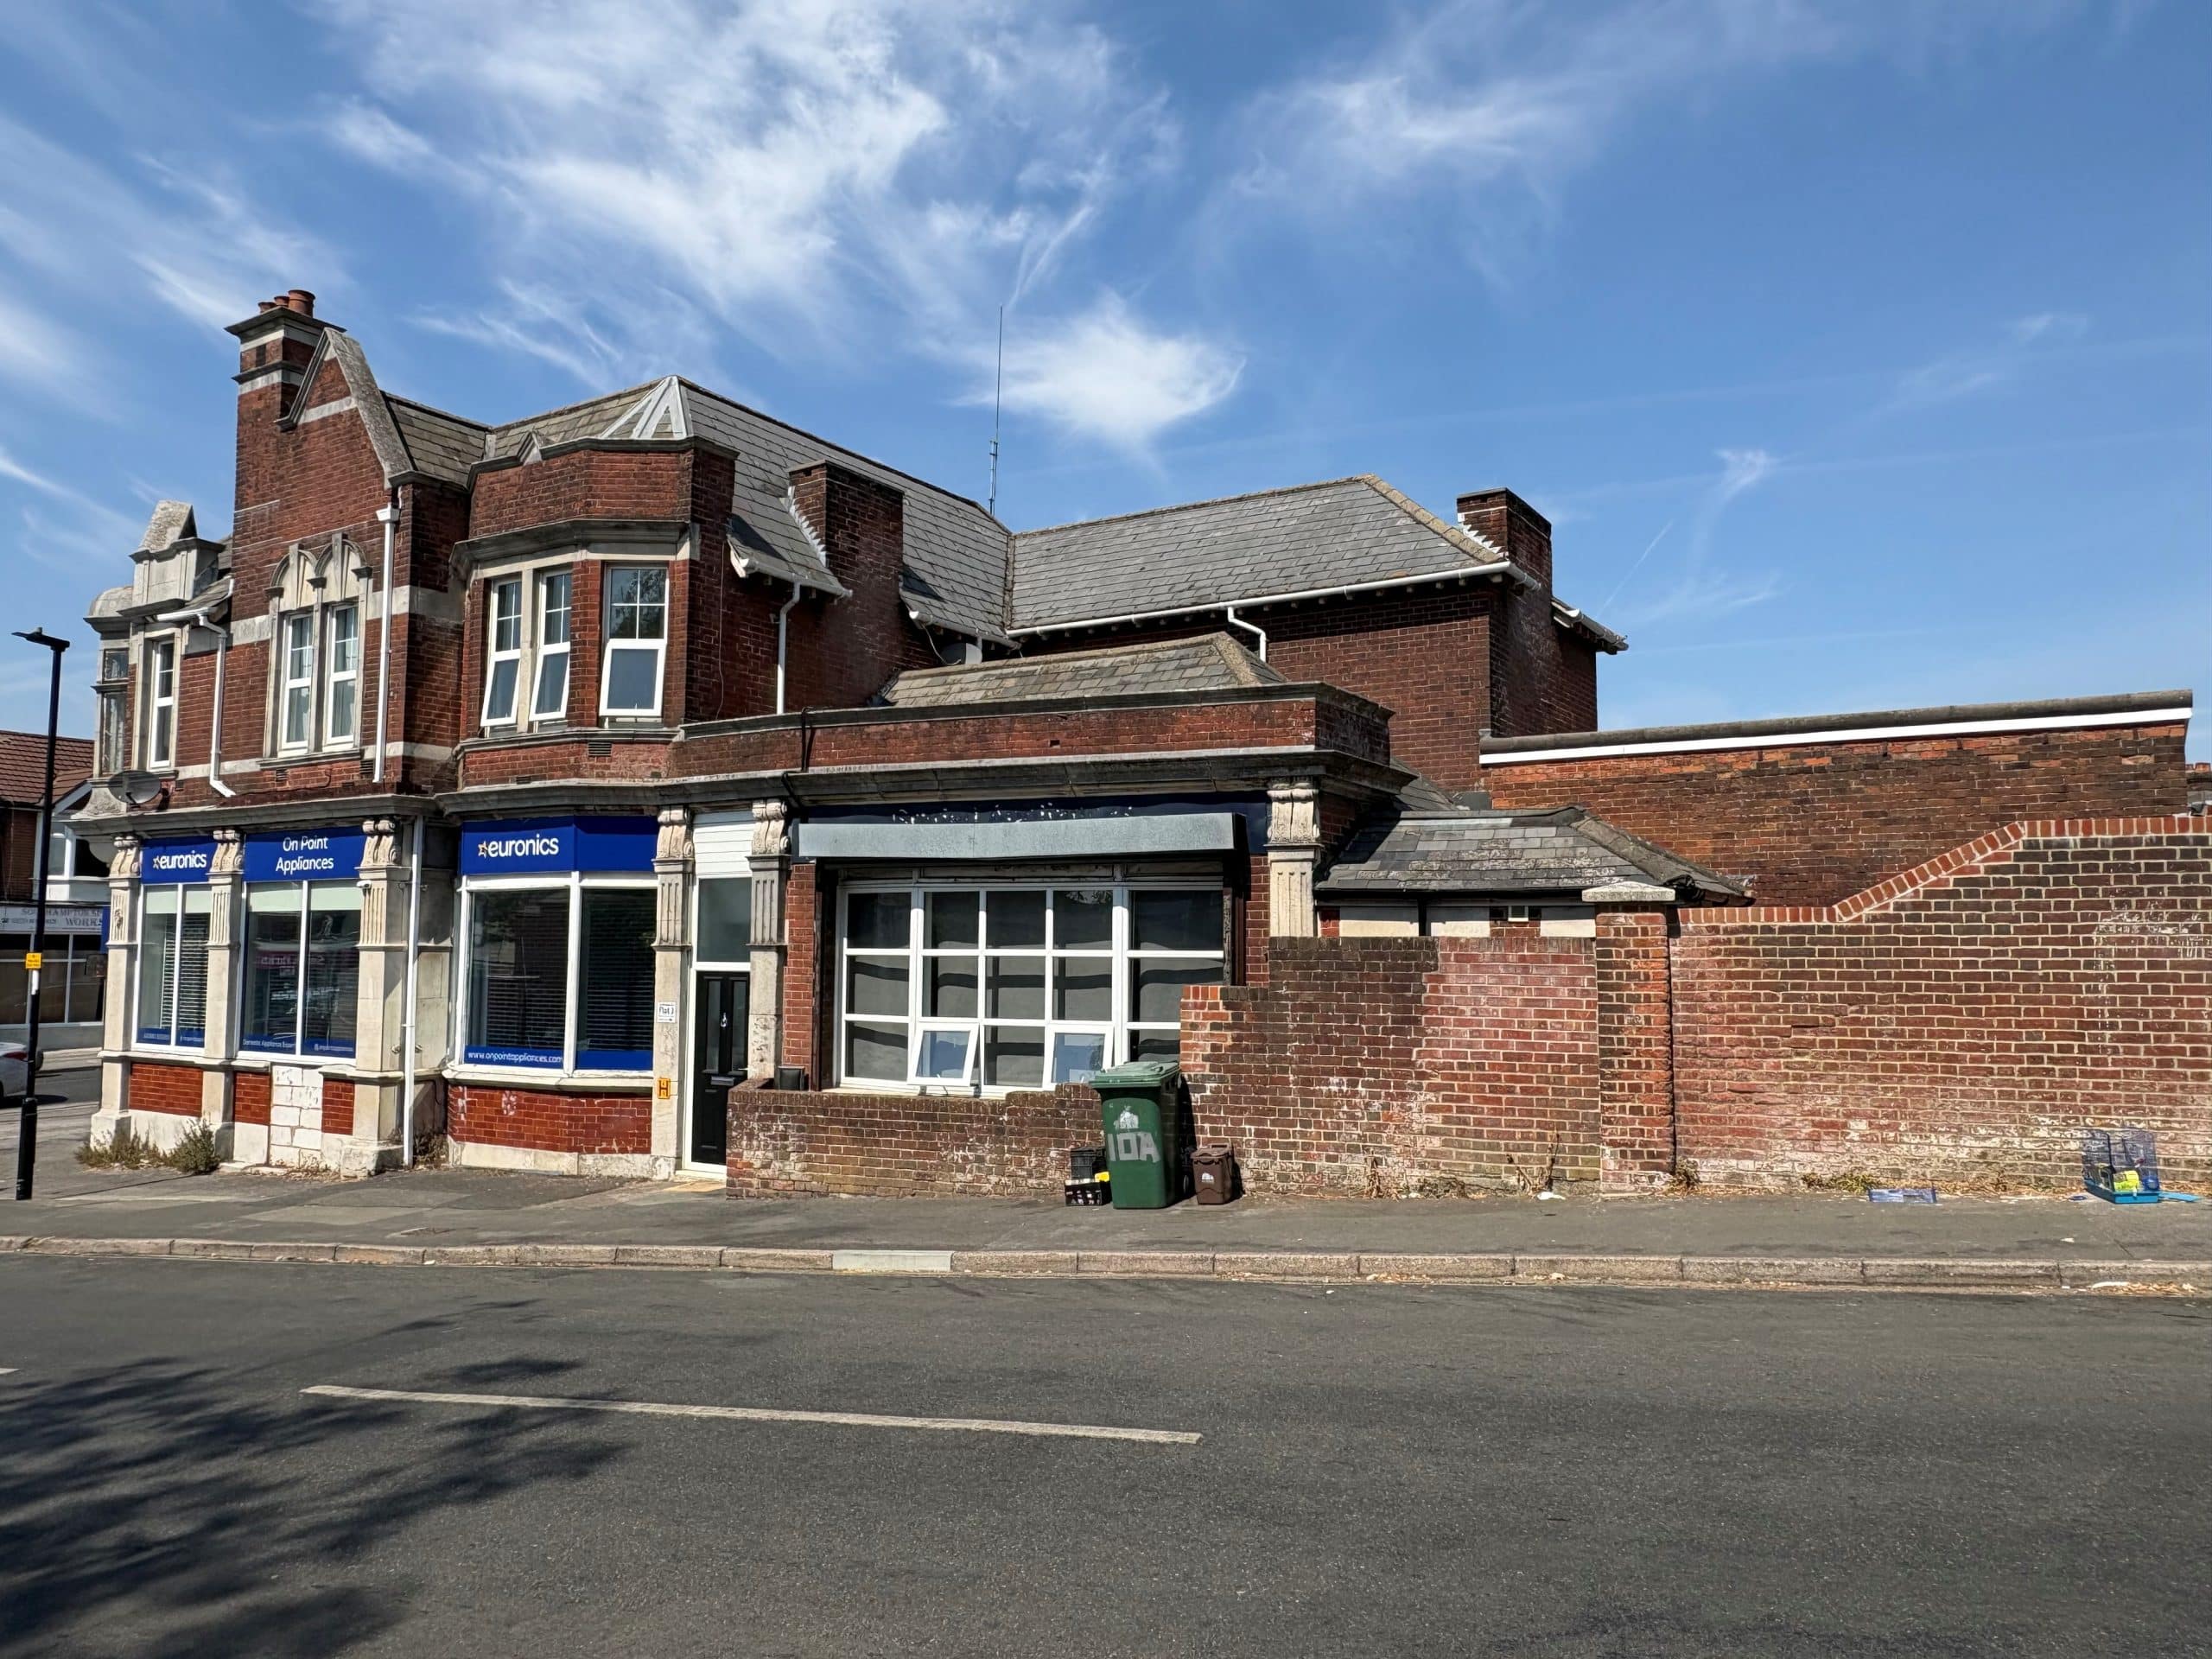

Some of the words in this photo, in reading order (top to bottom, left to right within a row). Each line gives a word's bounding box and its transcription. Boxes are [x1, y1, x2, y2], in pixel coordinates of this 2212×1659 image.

[283, 836, 298, 851] On
[302, 836, 328, 850] Point
[488, 834, 559, 857] euronics
[160, 850, 207, 869] euronics
[276, 856, 334, 875] Appliances
[1108, 1132, 1161, 1163] 10A
